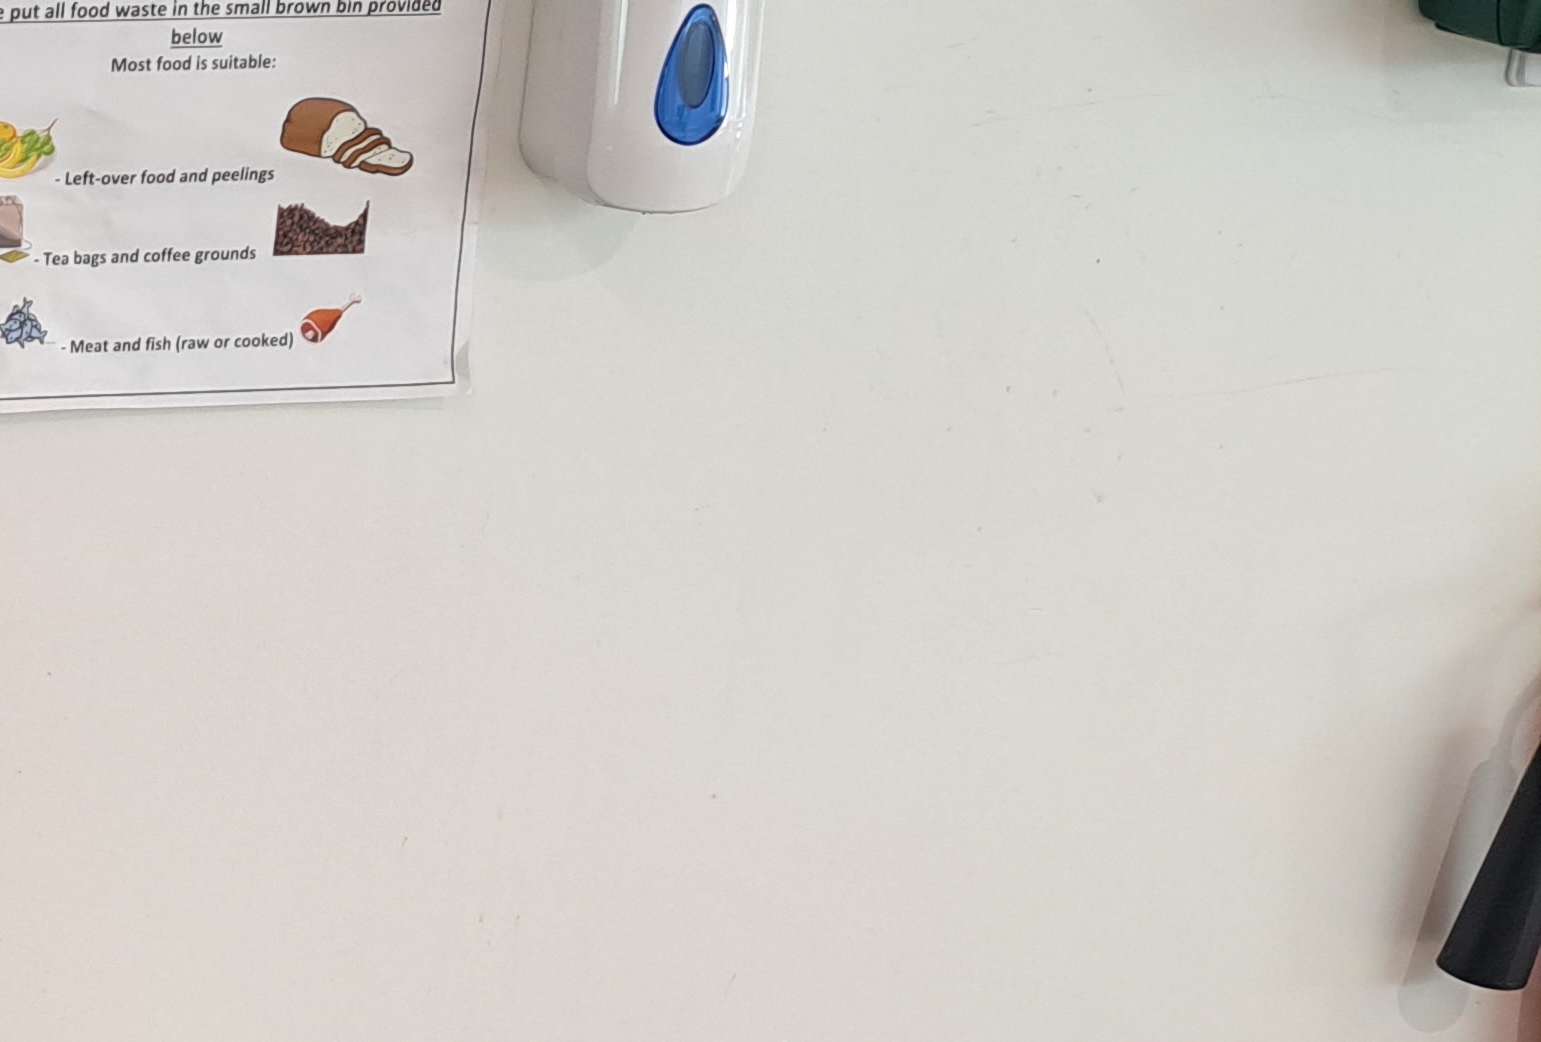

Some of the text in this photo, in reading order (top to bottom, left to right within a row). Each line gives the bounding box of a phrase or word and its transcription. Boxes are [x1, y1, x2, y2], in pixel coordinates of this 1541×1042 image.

[10, 4, 39, 23] put
[45, 2, 64, 19] all
[70, 2, 110, 18] food
[116, 1, 167, 17] waste
[173, 0, 187, 16] in
[194, 0, 220, 15] the
[226, 0, 269, 15] small
[275, 0, 330, 14] brown
[336, 0, 362, 13] bin
[367, 0, 441, 15] provided
[171, 28, 222, 45] below
[111, 54, 276, 72] Most food is suitable:
[65, 166, 275, 186] Left-over food and peelings
[43, 246, 256, 268] Tea bags and coffee grounds
[69, 331, 293, 354] Meat and fish (raw or cooked)
